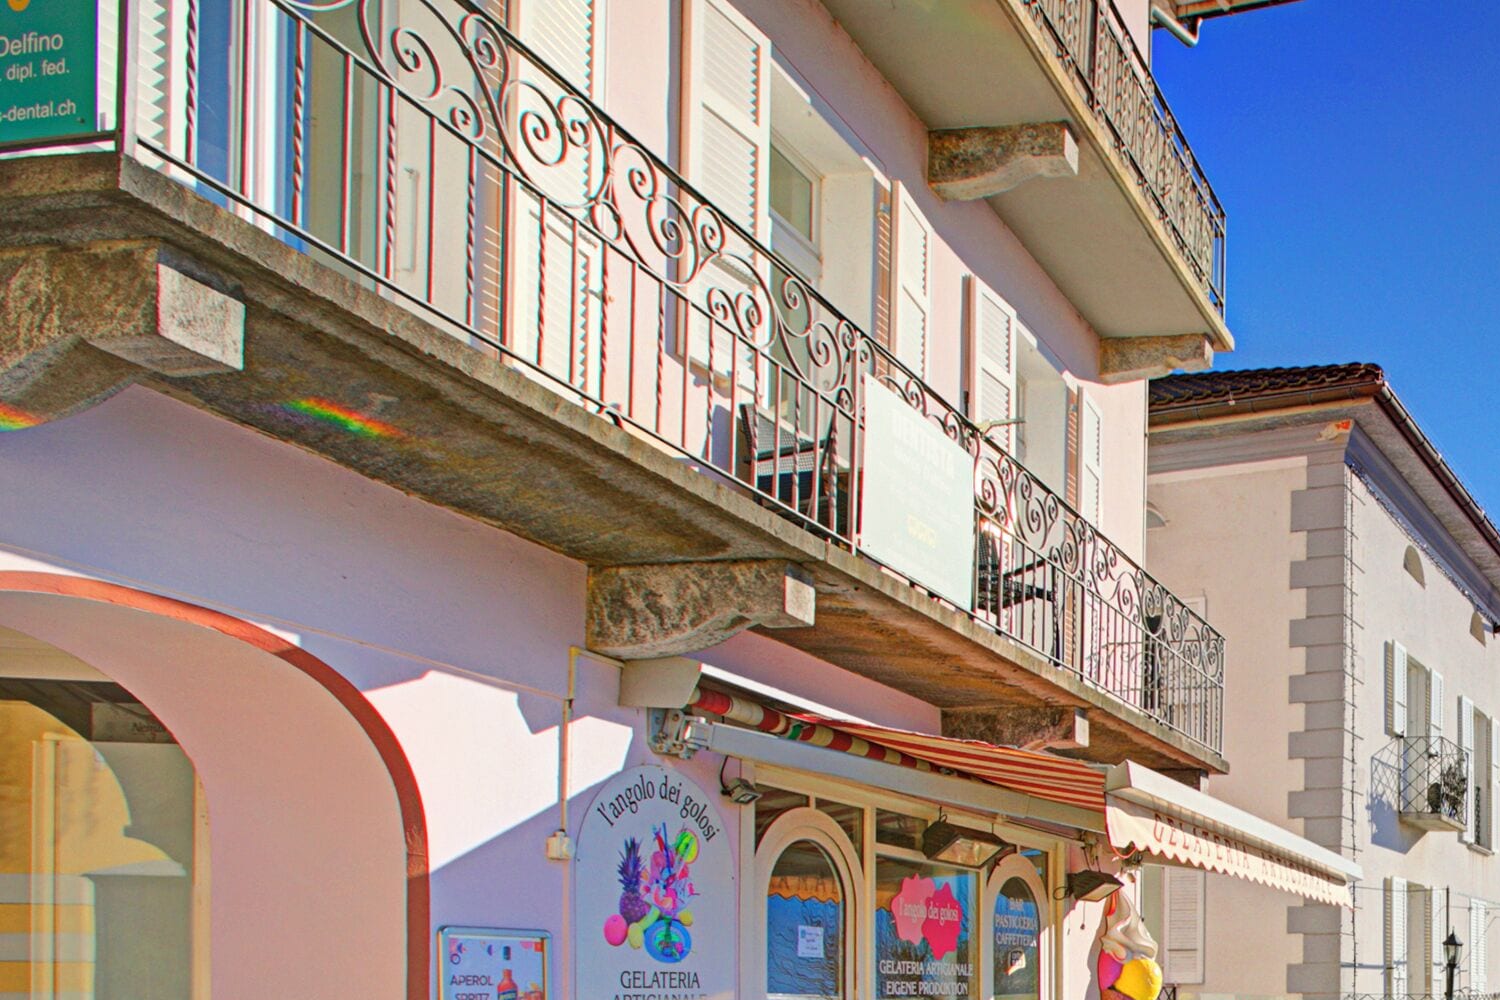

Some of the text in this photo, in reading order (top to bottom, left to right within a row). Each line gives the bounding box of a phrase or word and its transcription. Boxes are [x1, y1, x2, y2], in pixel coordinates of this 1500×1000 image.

[6, 58, 70, 83] dipl. fed.
[0, 99, 76, 121] -dental.ch
[597, 774, 720, 842] l'angolo dei golosi
[1153, 814, 1250, 869] GELATERIA
[928, 901, 939, 920] dei
[940, 903, 959, 927] golosi
[620, 970, 700, 989] GELATERIA
[879, 960, 974, 977] GELATERIA ARTIGIANALE
[450, 975, 495, 986] APEROL
[886, 980, 969, 996] EIGENE PRODUKTION
